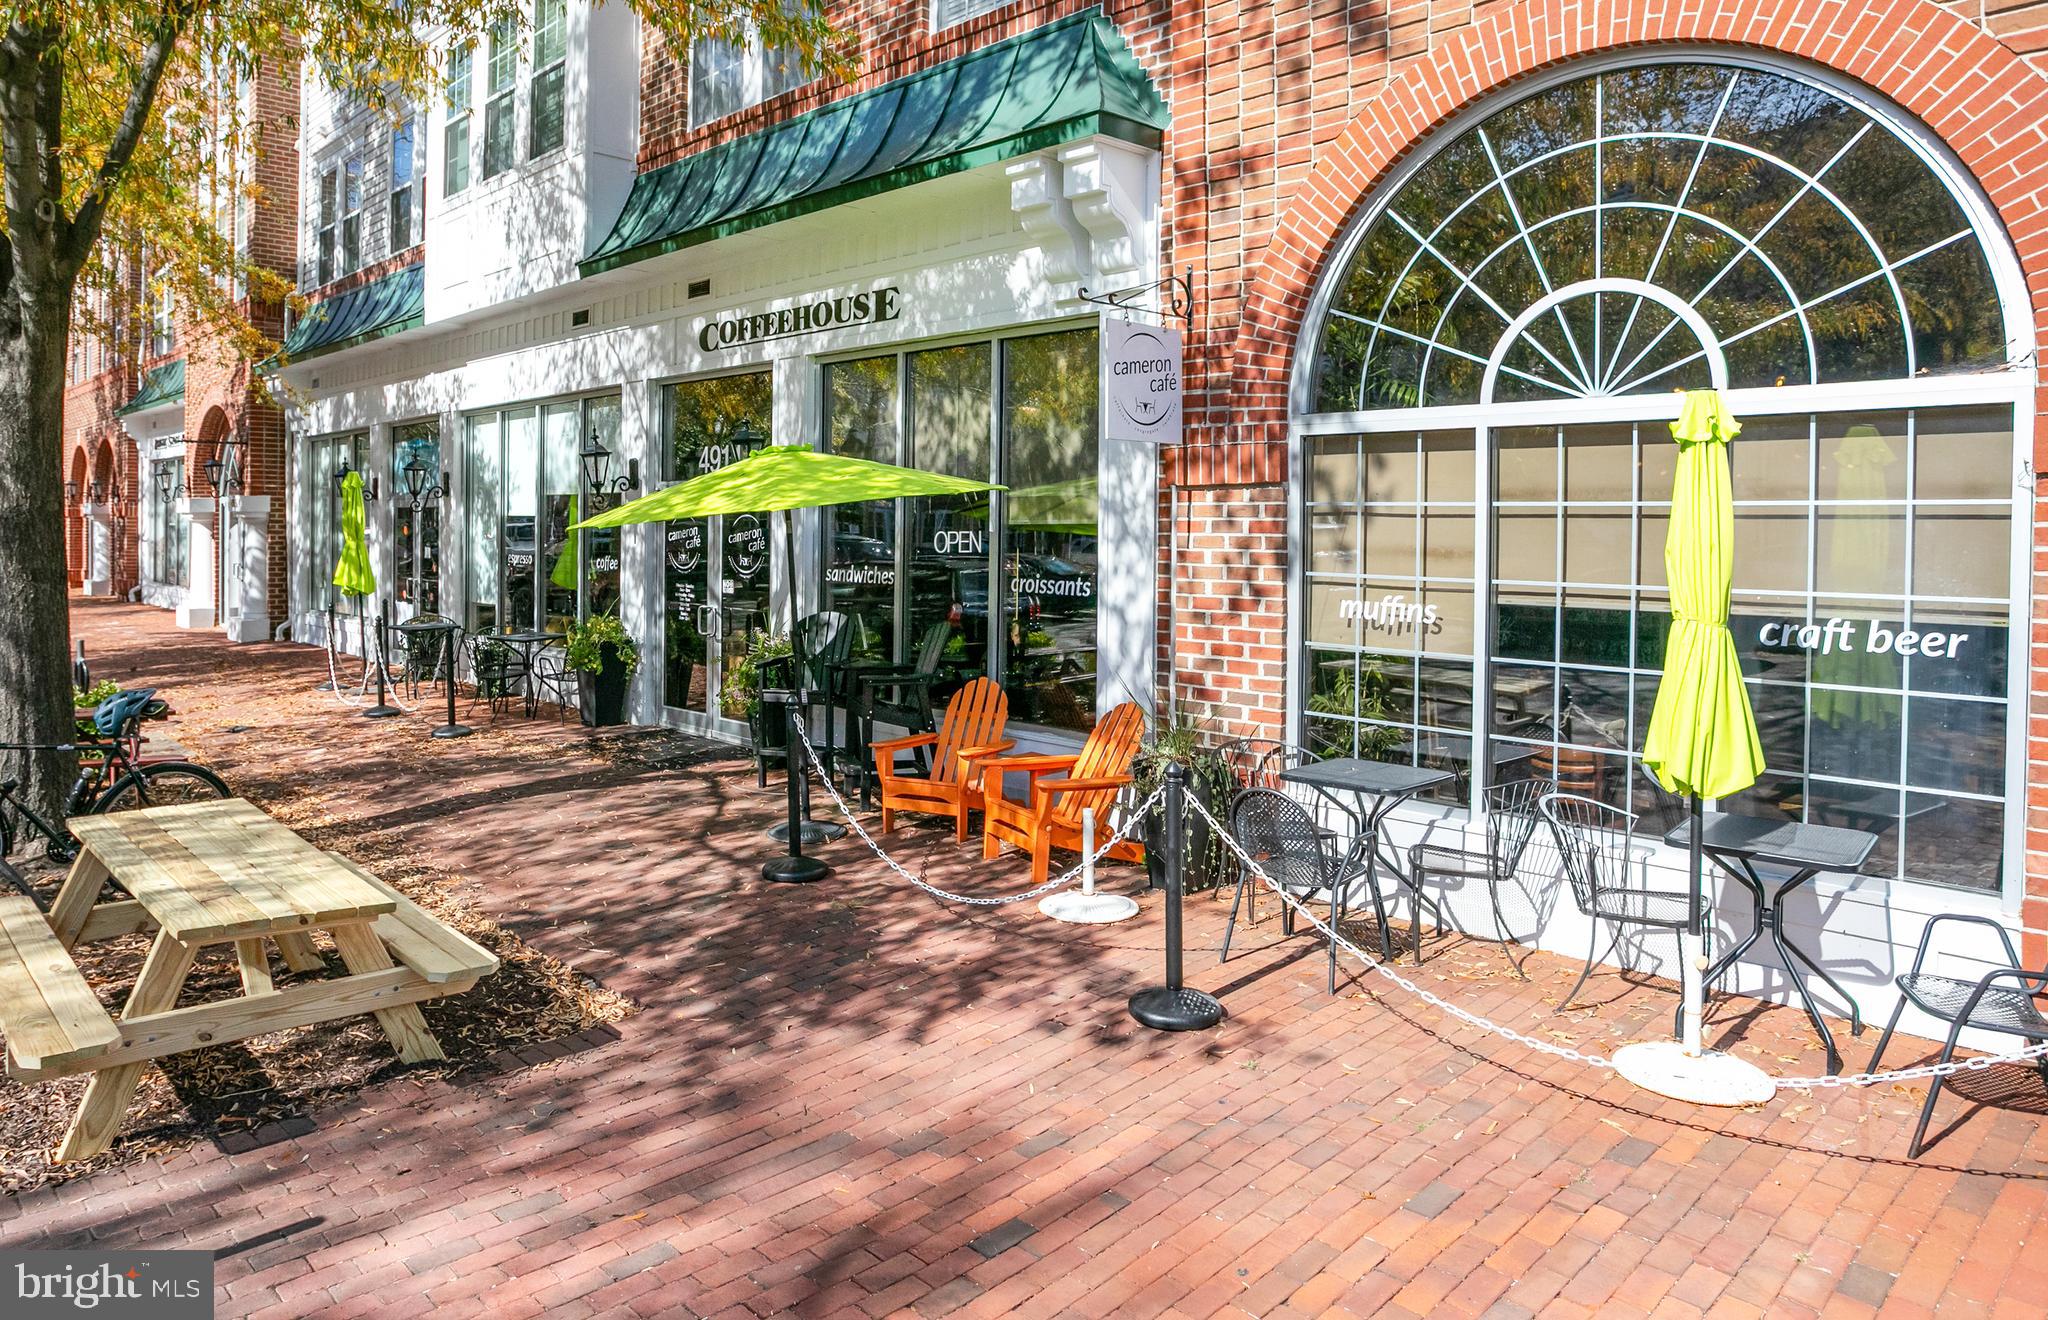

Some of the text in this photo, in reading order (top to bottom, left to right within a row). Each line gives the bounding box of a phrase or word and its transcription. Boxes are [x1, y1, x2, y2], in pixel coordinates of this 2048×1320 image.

[700, 286, 901, 352] COFFEEHOUSE
[1113, 358, 1172, 376] cameron
[1149, 373, 1177, 392] café
[668, 526, 699, 542] cameron
[685, 535, 701, 549] café
[728, 528, 762, 544] cameron
[933, 530, 982, 554] OPEN
[748, 537, 766, 552] café
[507, 553, 533, 566] espresso
[596, 555, 619, 571] coffee
[825, 565, 895, 585] sandwiches
[1010, 574, 1092, 598] croissants
[1339, 594, 1438, 625] muffins
[1759, 617, 1969, 659] craft beer
